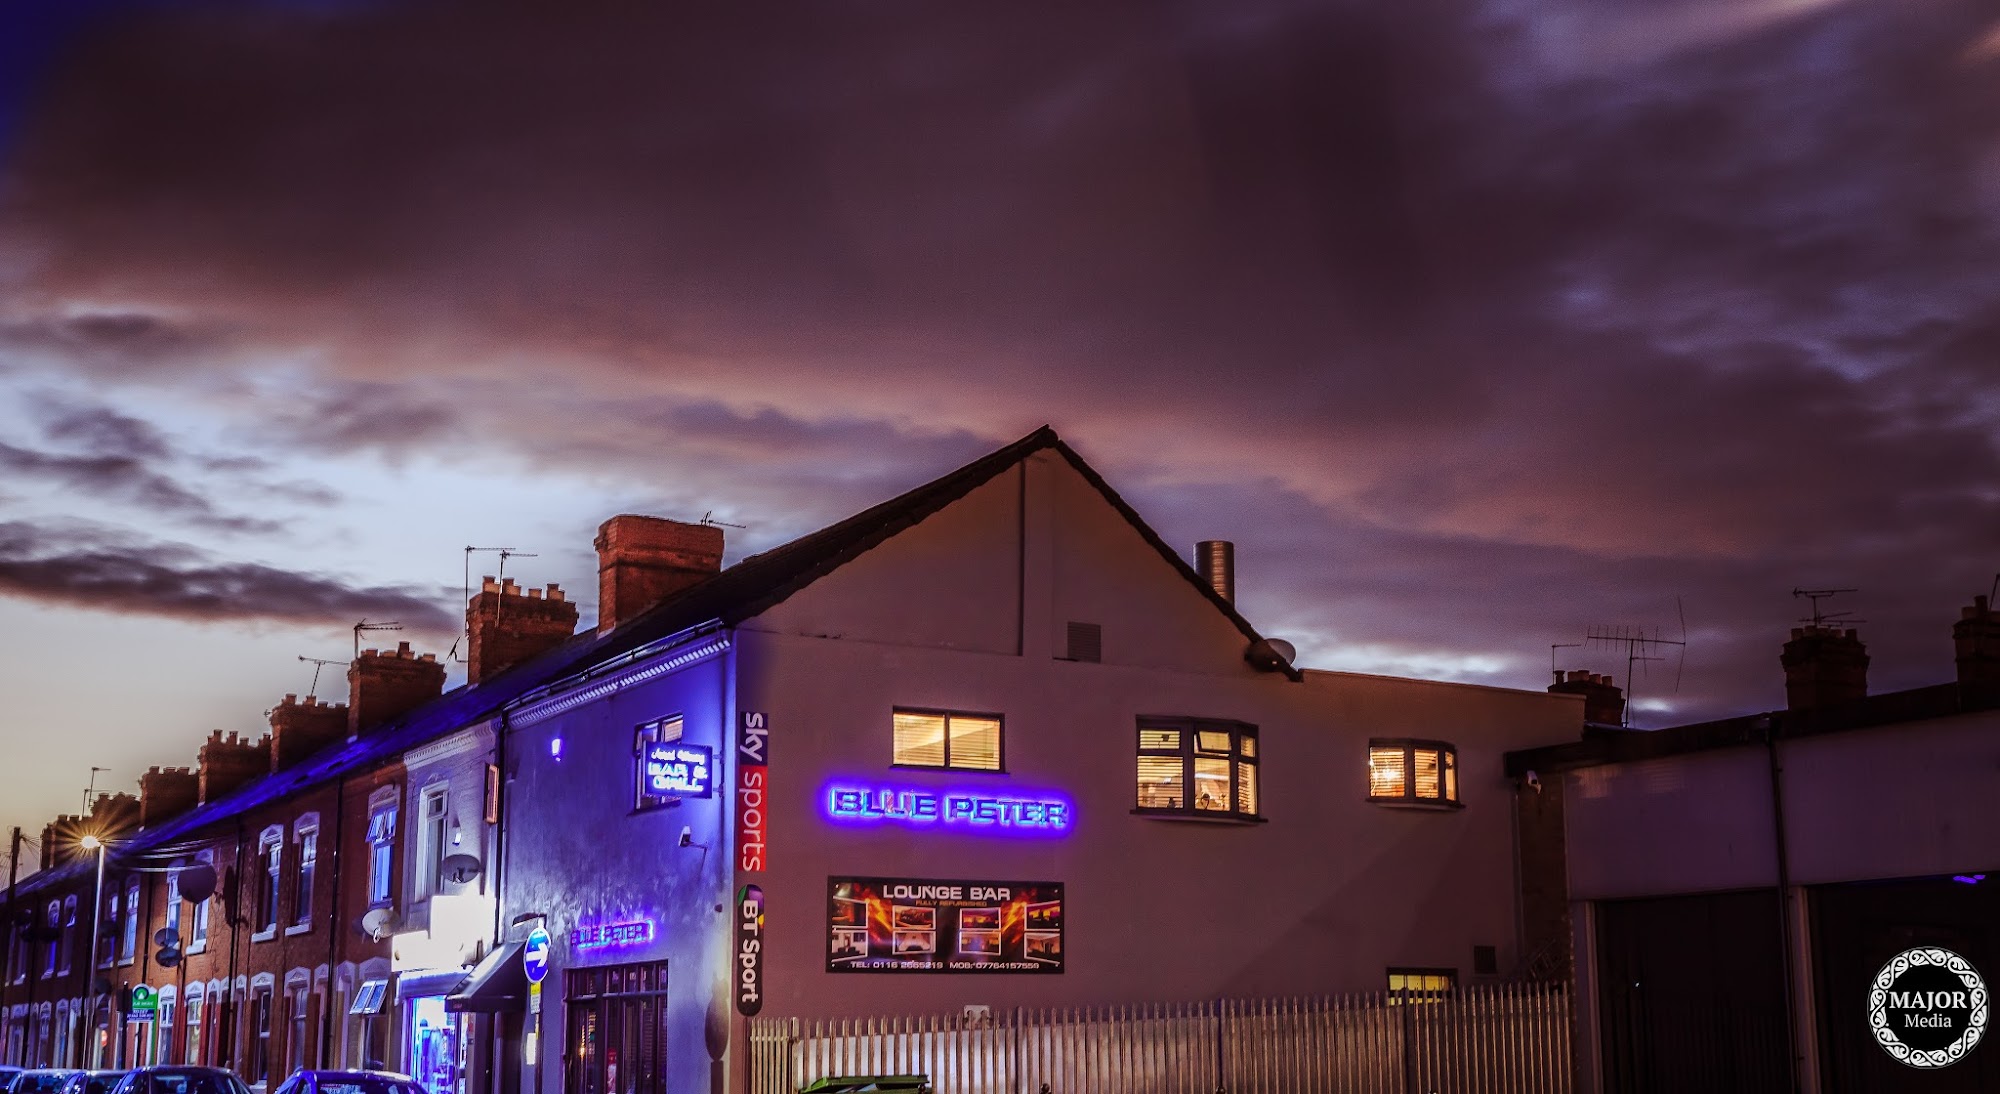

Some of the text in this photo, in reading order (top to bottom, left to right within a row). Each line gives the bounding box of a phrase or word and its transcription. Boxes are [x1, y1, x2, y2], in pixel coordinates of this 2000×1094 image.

[738, 712, 768, 872] sky sports
[829, 788, 1068, 827] BLUE PETER
[883, 885, 1011, 901] LOUNGE BAR
[739, 899, 760, 1003] BT Sport
[850, 961, 870, 969] TEL:
[873, 961, 898, 969] 0116
